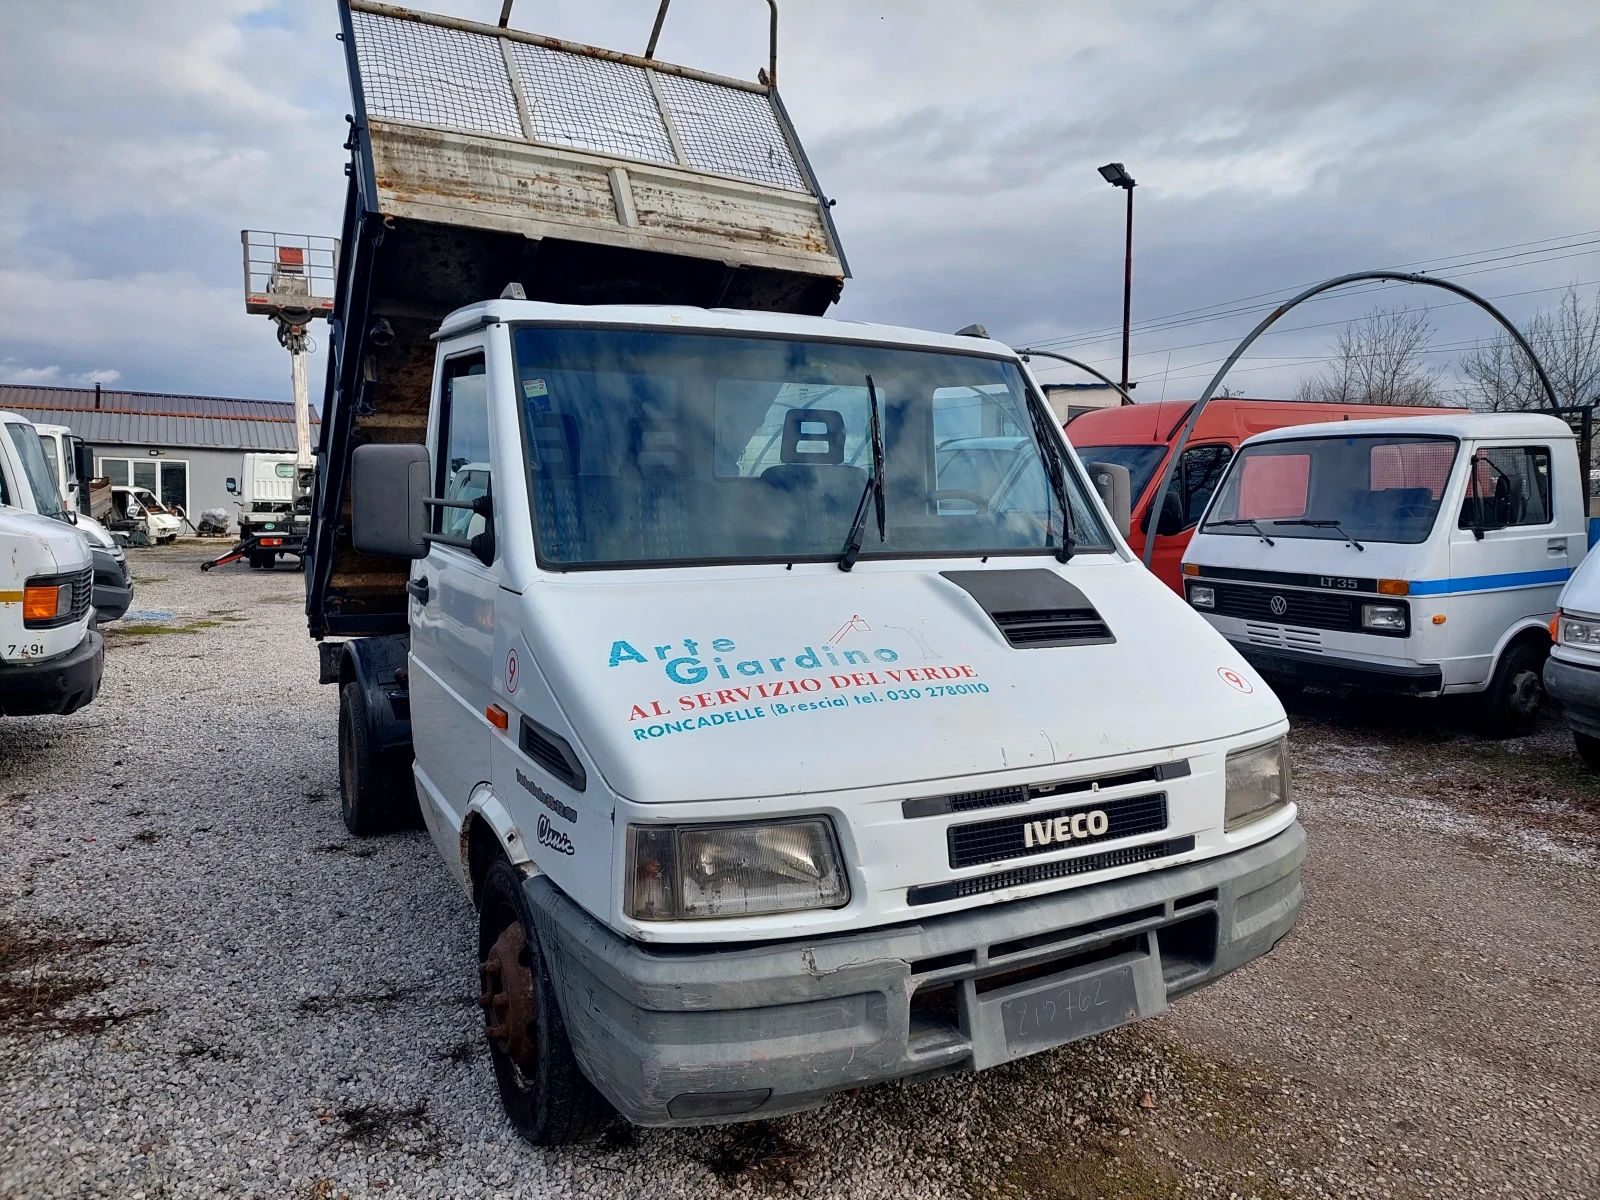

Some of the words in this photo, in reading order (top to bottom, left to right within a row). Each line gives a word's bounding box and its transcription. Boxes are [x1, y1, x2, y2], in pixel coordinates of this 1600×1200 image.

[1320, 577, 1335, 587] LT
[1337, 578, 1358, 589] 35
[608, 637, 736, 668] Arte
[665, 645, 899, 685] Giardino
[509, 656, 516, 685] 9
[1224, 671, 1244, 689] 9
[628, 701, 671, 721] AL
[677, 678, 822, 712] SERVIZIO
[633, 706, 766, 741] RONCADELLE
[770, 694, 850, 717] (Brescia)
[853, 691, 884, 705] tel.
[886, 688, 921, 701] 030
[925, 683, 990, 698] 2780110
[1023, 810, 1109, 849] IVECO
